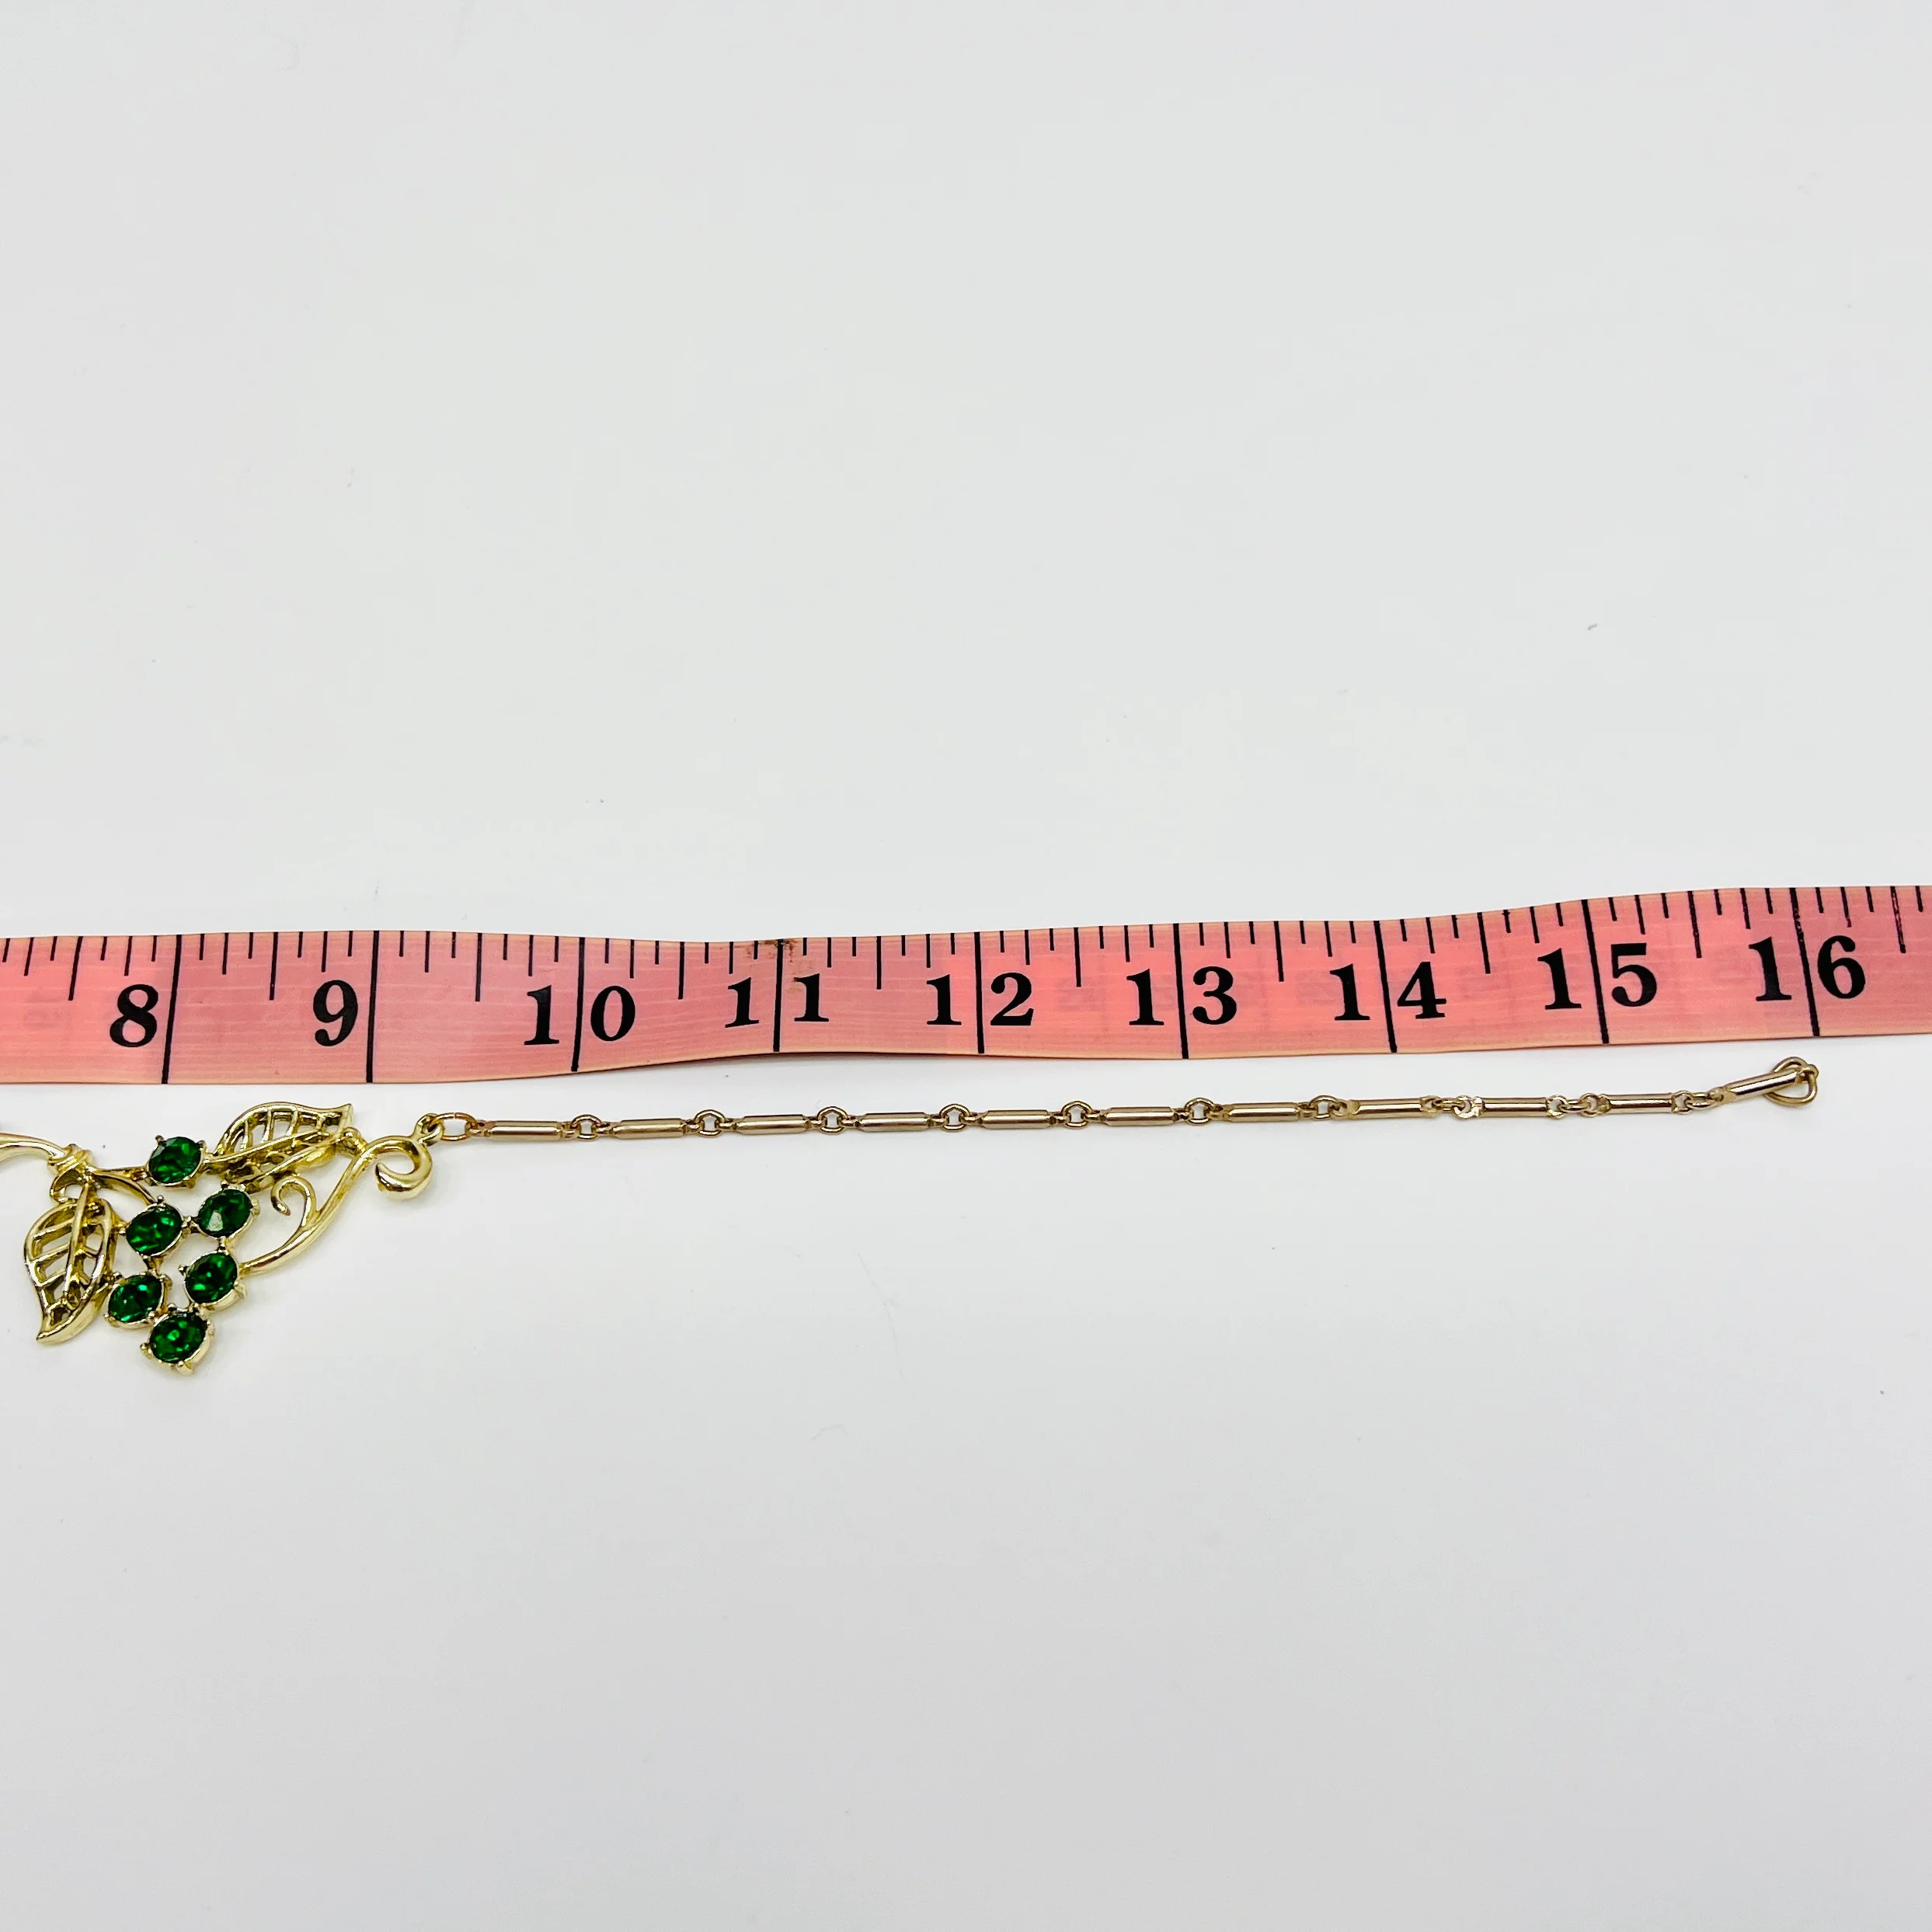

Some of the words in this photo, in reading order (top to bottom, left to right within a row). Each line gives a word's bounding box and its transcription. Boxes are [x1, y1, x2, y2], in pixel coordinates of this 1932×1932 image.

[109, 983, 159, 1048] 8
[312, 979, 359, 1047] 9
[524, 984, 636, 1046] 10
[725, 973, 830, 1029] 11
[926, 972, 1034, 1026] 12
[1126, 966, 1238, 1026] 13
[1329, 961, 1447, 1021] 14
[1537, 942, 1658, 1011] 15
[1749, 935, 1866, 1002] 16
